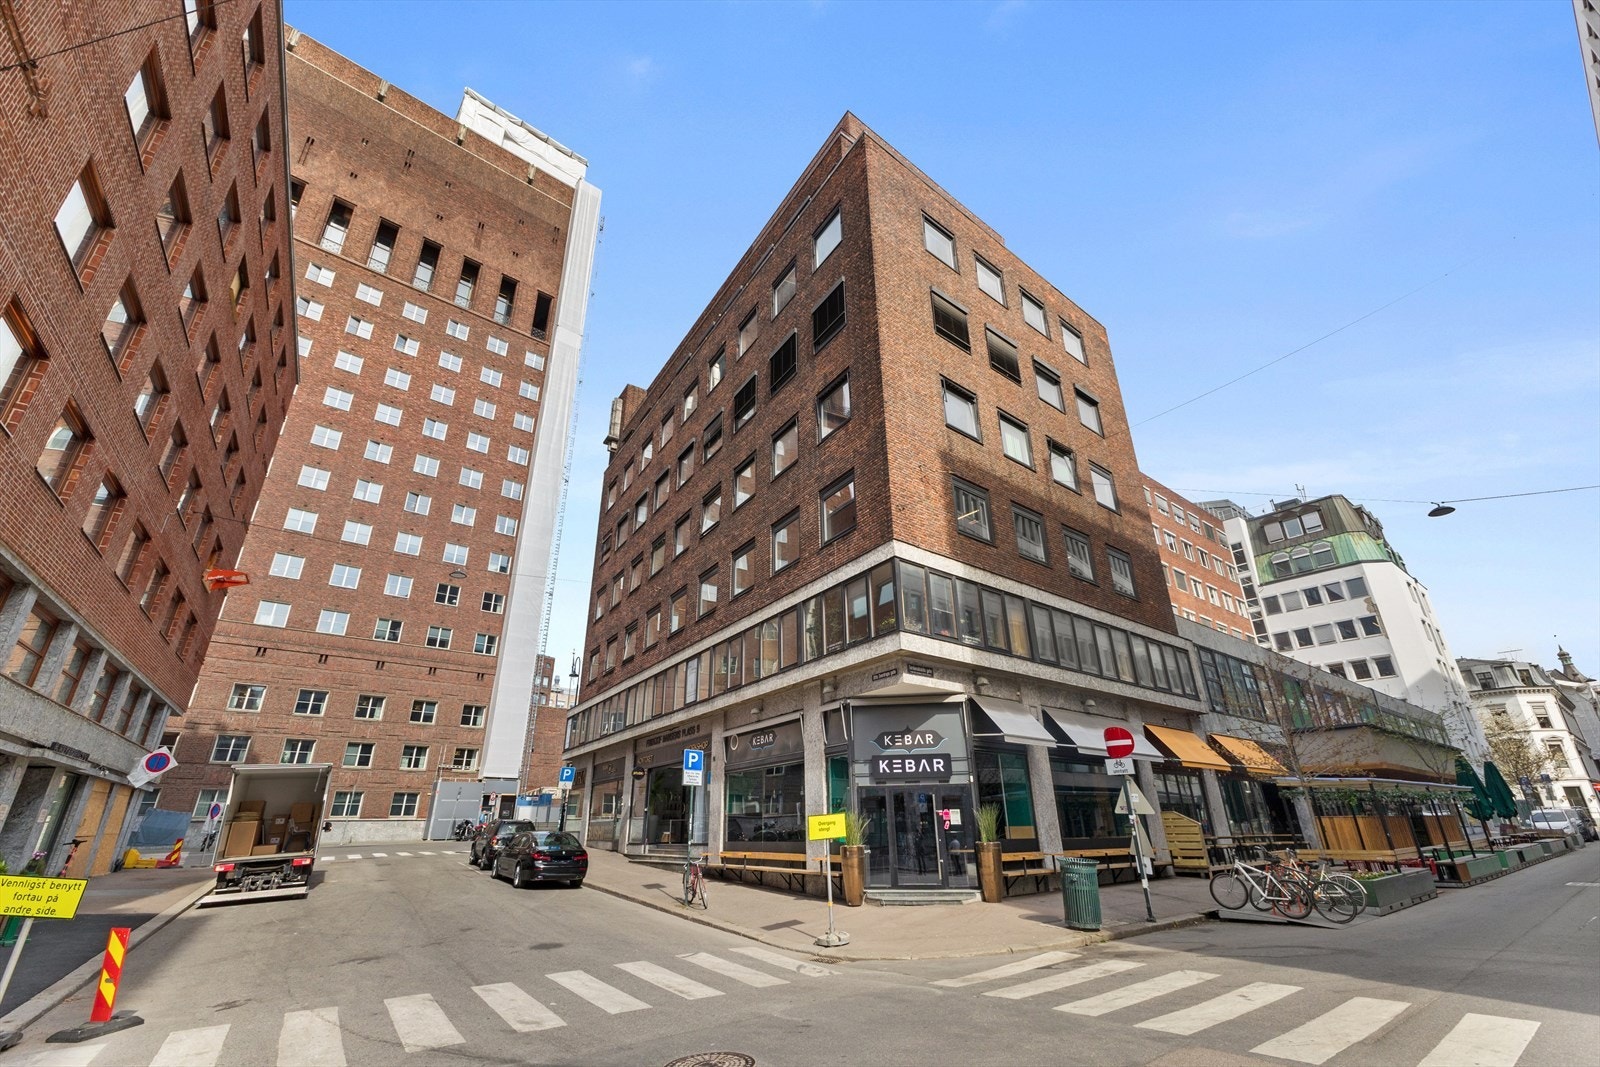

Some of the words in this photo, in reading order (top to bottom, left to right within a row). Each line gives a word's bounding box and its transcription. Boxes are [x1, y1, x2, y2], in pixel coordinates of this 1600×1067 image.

[752, 733, 774, 746] KEBAR
[884, 733, 934, 746] KEBAR
[688, 752, 699, 768] P
[879, 758, 945, 773] KEBAR
[562, 768, 571, 780] P
[1, 878, 46, 891] Vennligst
[49, 881, 82, 892] benytt
[13, 892, 42, 902] fortau
[46, 894, 59, 904] på
[3, 905, 32, 914] andre
